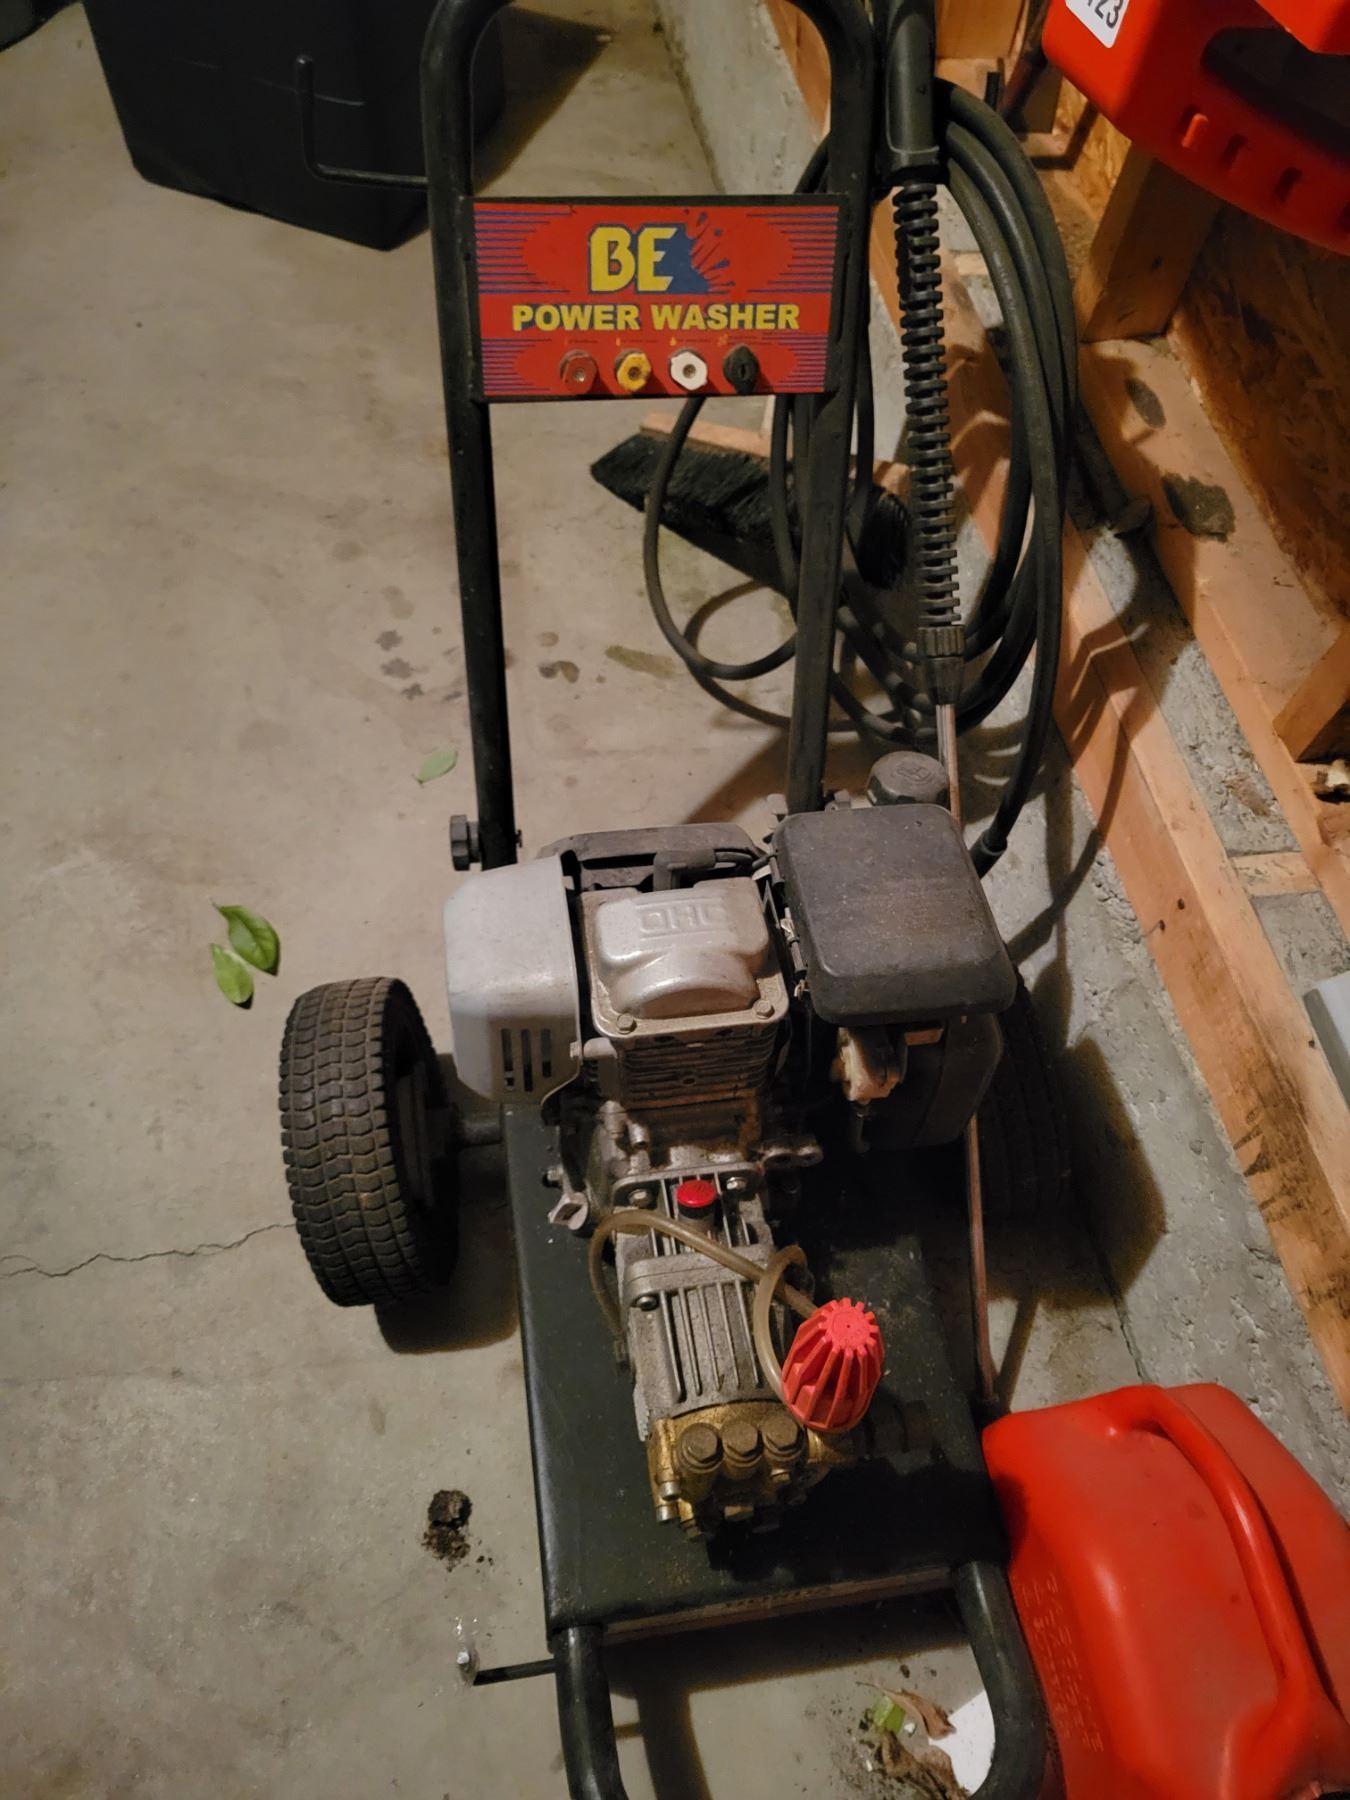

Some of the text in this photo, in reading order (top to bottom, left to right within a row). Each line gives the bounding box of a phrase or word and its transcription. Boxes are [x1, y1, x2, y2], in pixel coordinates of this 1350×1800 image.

[1087, 0, 1124, 28] 23
[589, 226, 677, 293] BE
[513, 304, 799, 332] POWER WASHER
